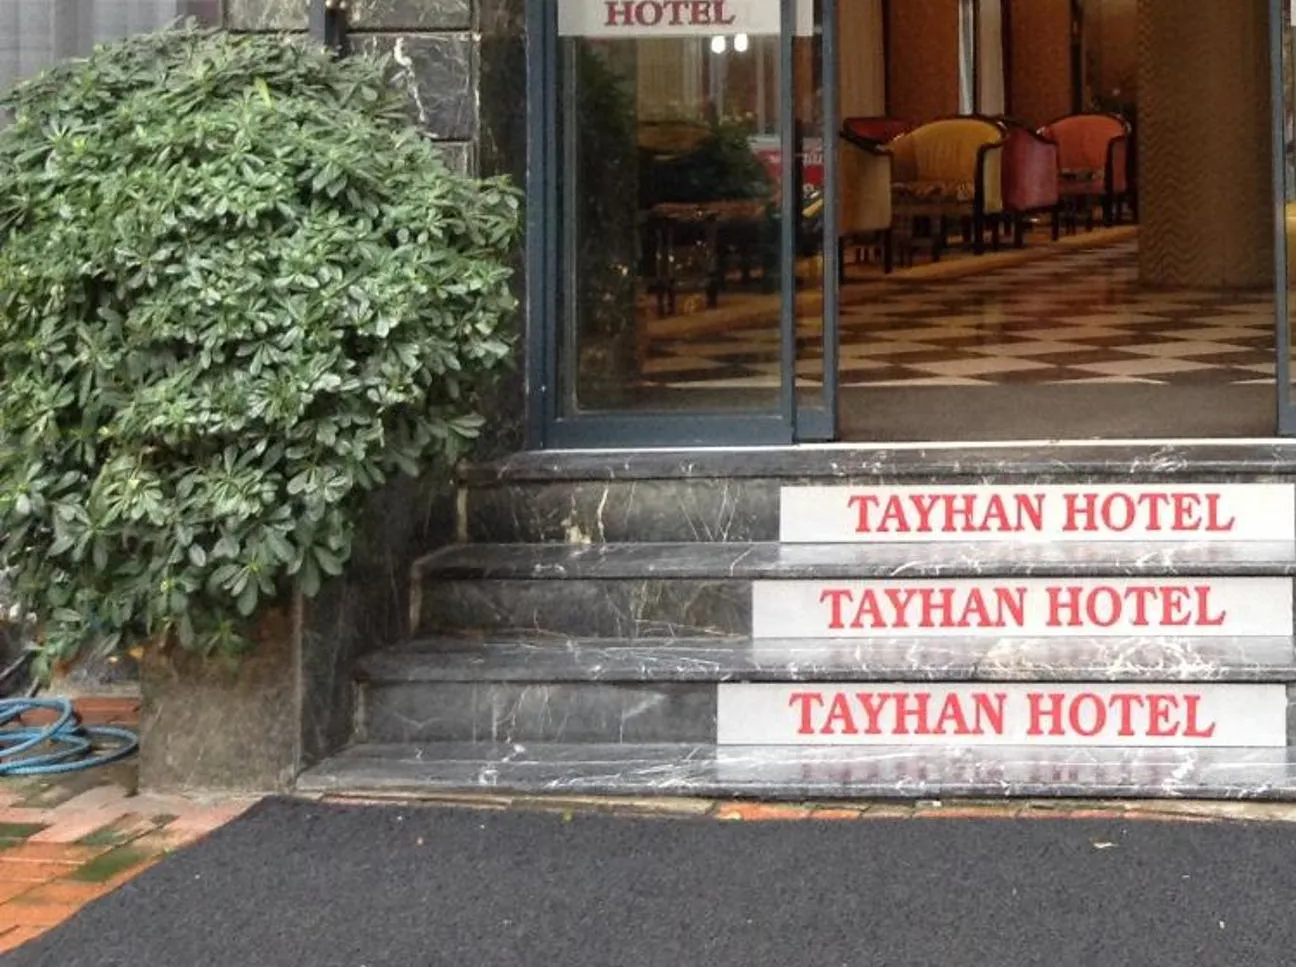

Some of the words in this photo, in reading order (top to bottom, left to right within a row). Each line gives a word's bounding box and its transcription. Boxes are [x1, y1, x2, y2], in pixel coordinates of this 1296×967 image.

[604, 0, 736, 26] HOTEL
[847, 493, 1045, 533] TAYHAN
[1063, 492, 1236, 532] HOTEL
[819, 586, 1027, 629] TAYHAN
[1046, 584, 1227, 628] HOTEL
[788, 691, 1008, 736] TAYHAN
[1026, 691, 1216, 738] HOTEL
